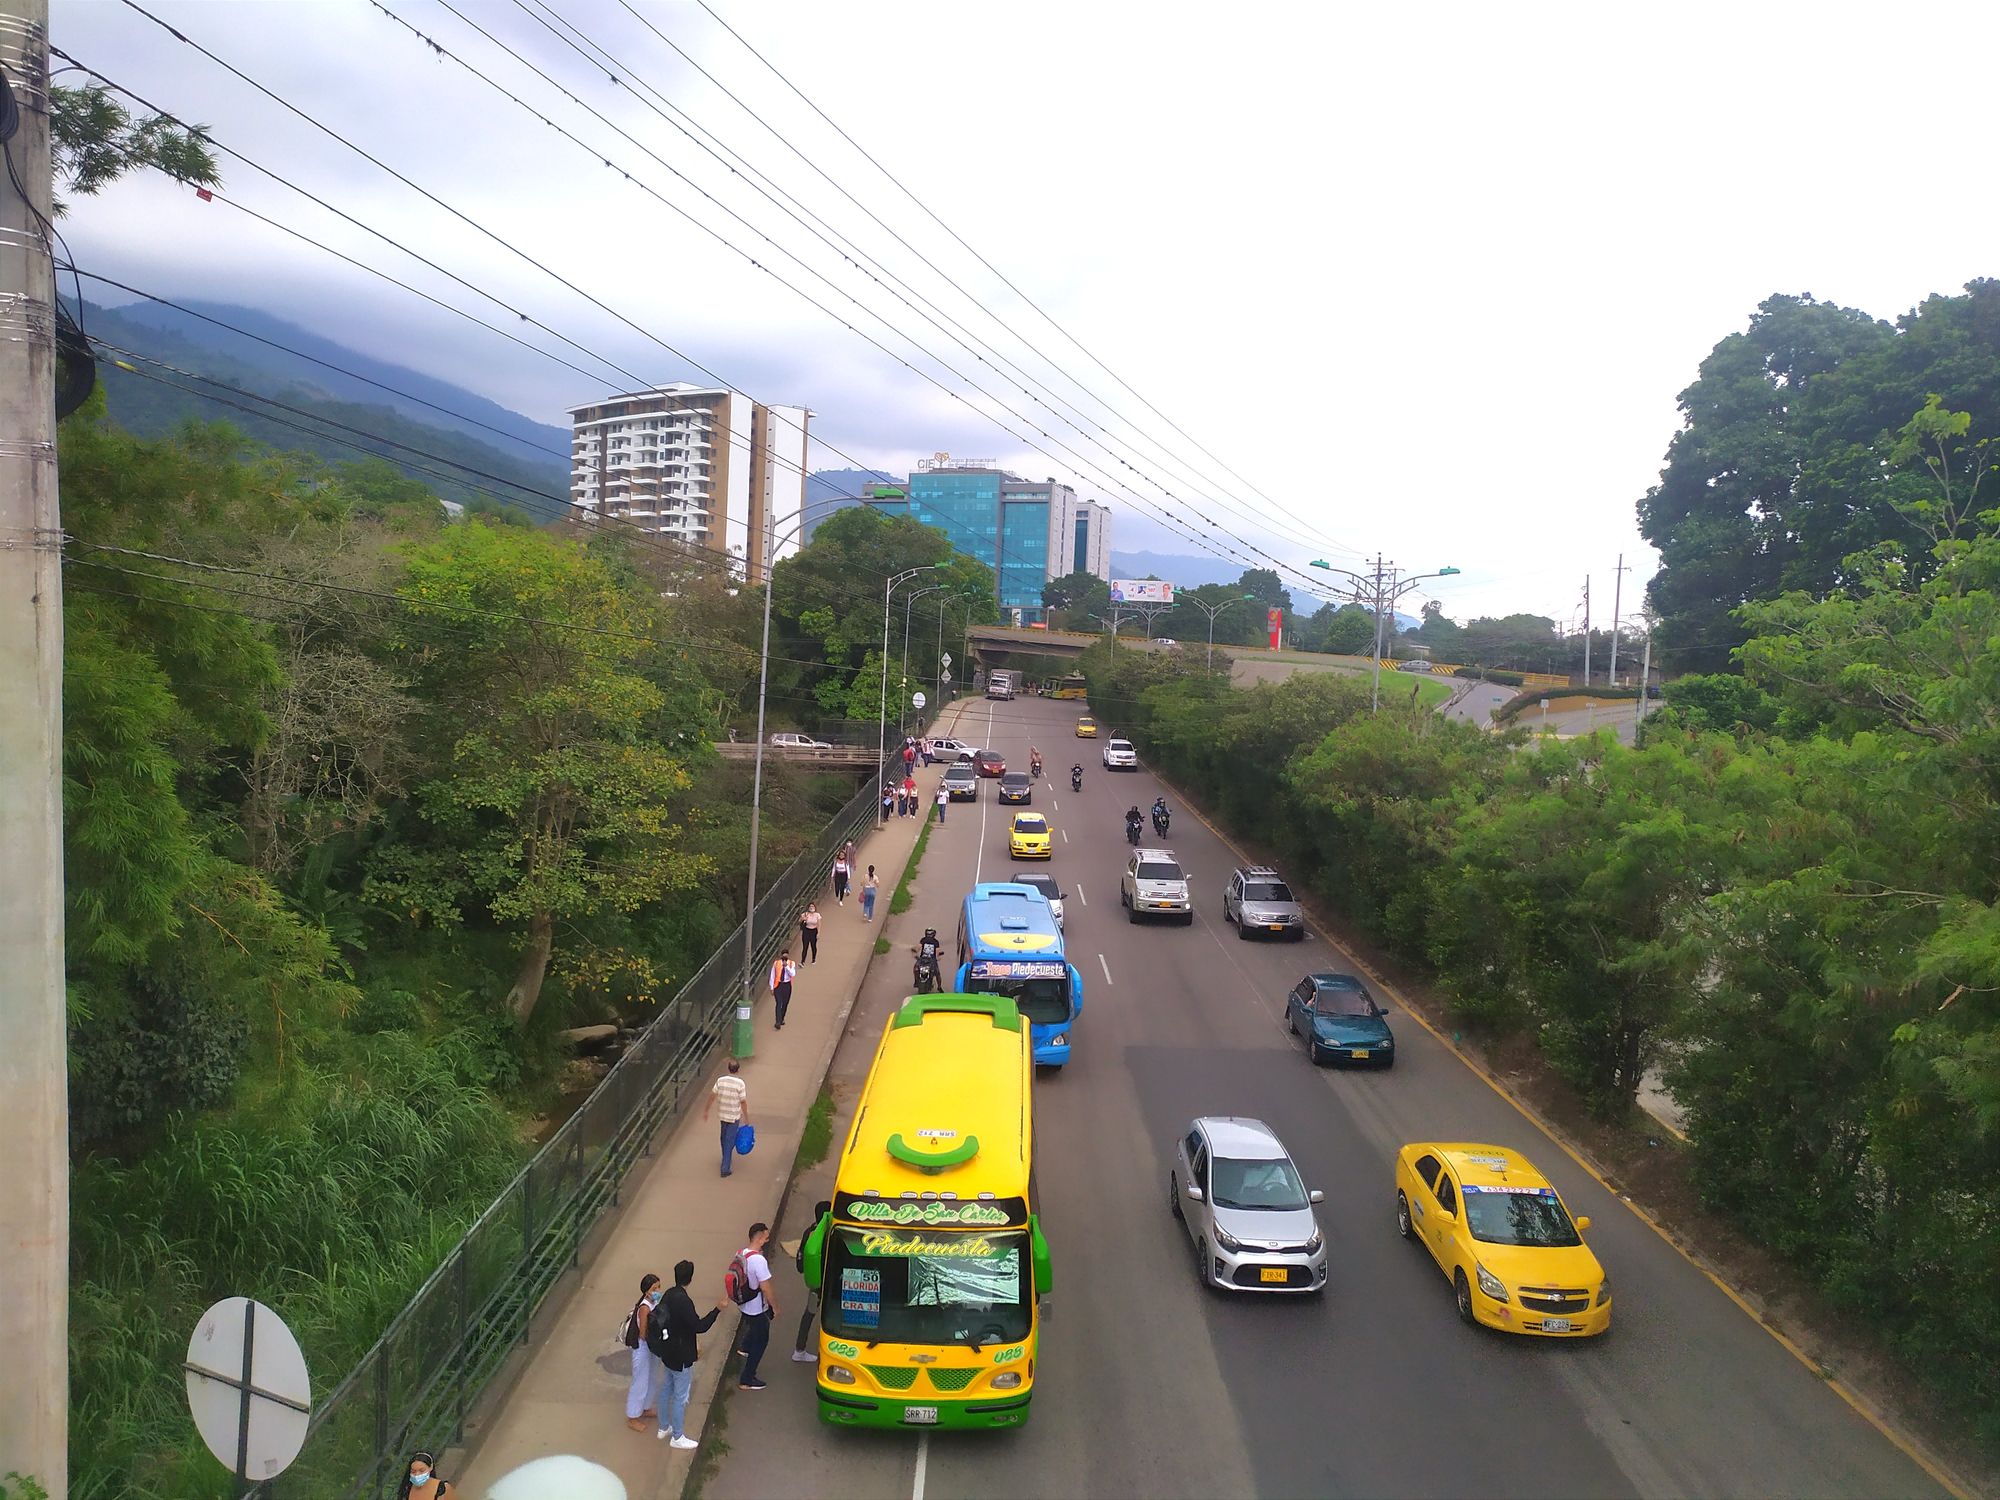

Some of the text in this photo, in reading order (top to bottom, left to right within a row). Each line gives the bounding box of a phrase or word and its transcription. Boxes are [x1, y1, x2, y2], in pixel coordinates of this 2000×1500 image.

[1012, 962, 1063, 976] Piedecuesta
[848, 1202, 1008, 1223] Villa De San Carlos
[862, 1233, 996, 1256] Piedecuesta
[862, 1273, 879, 1282] 50
[842, 1281, 879, 1291] FLORIDA
[842, 1301, 864, 1310] CRA
